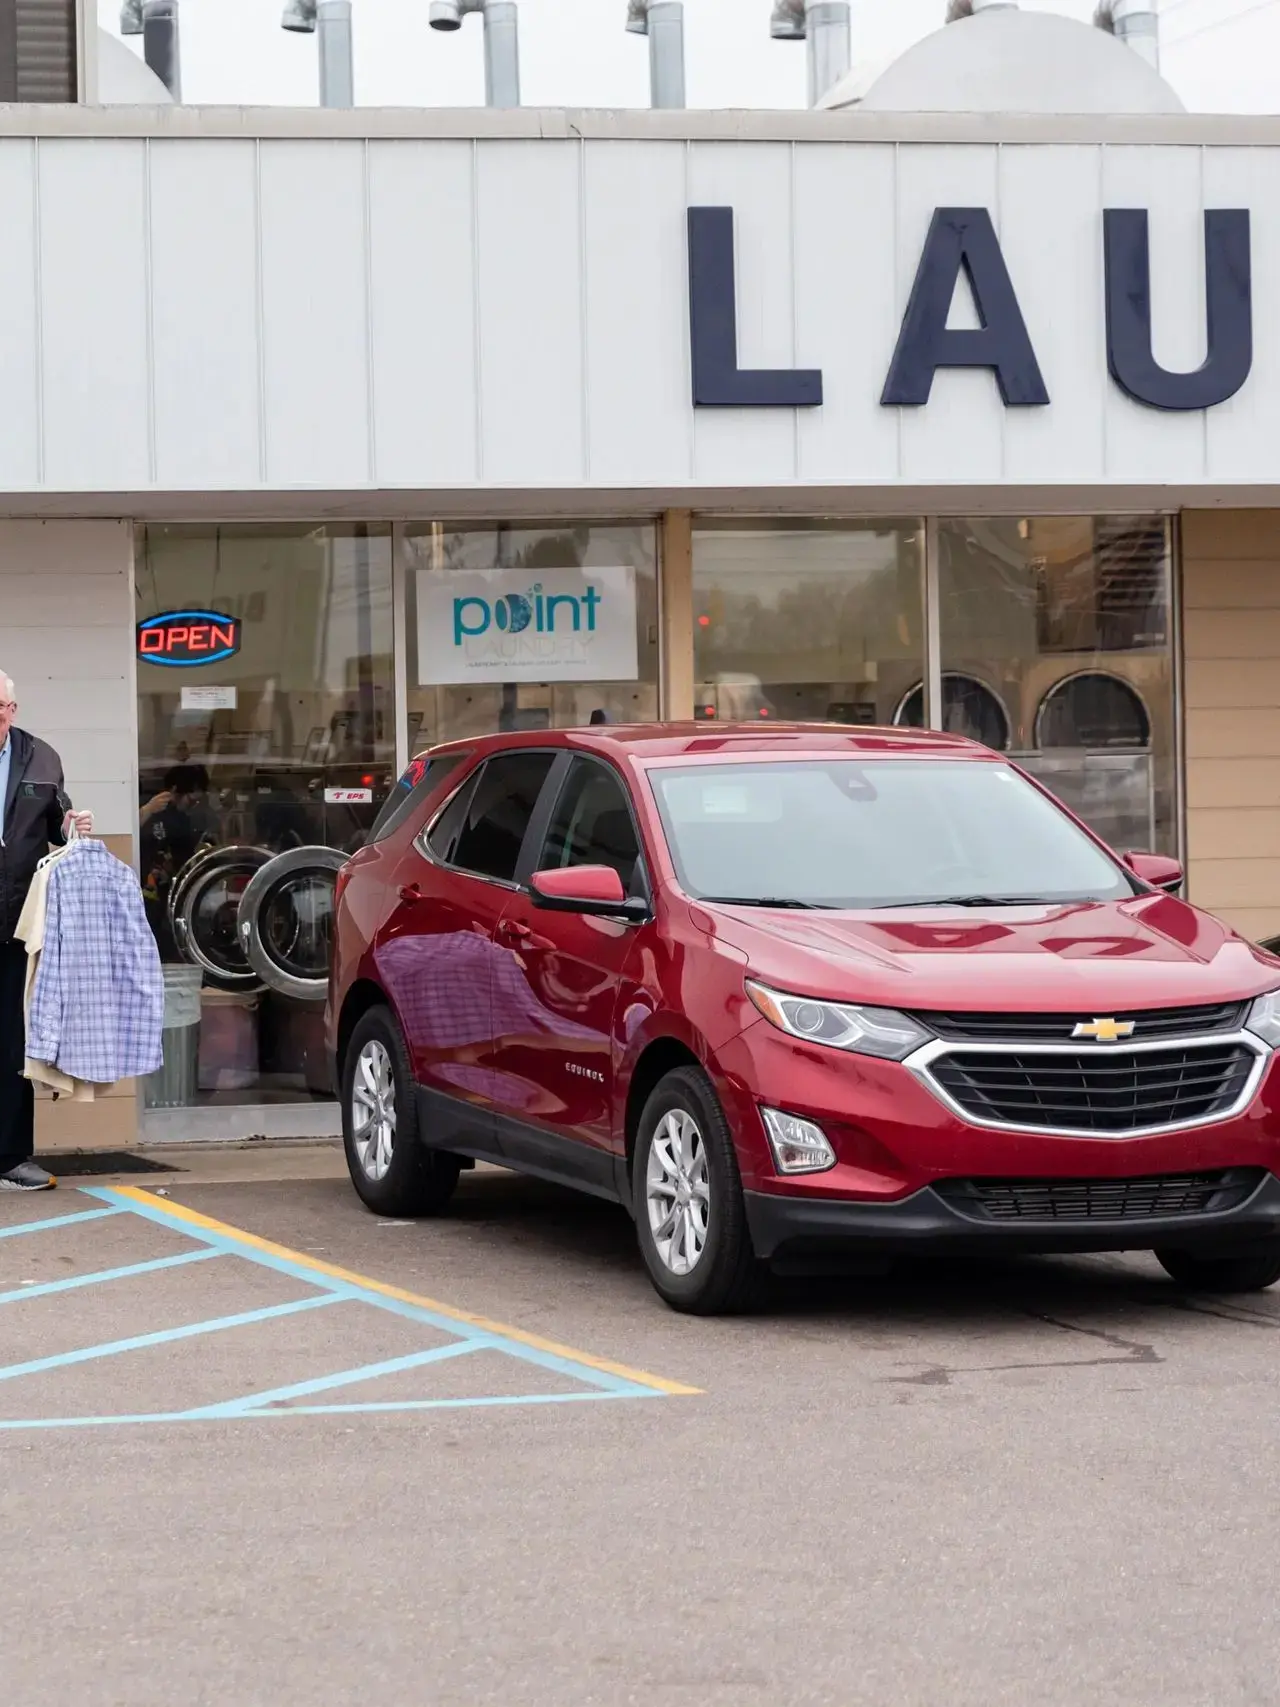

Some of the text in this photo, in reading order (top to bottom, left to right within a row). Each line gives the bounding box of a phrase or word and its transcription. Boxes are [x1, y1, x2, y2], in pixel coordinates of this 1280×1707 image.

[687, 206, 1253, 410] LAU
[140, 624, 235, 652] OPEN
[453, 583, 601, 646] point
